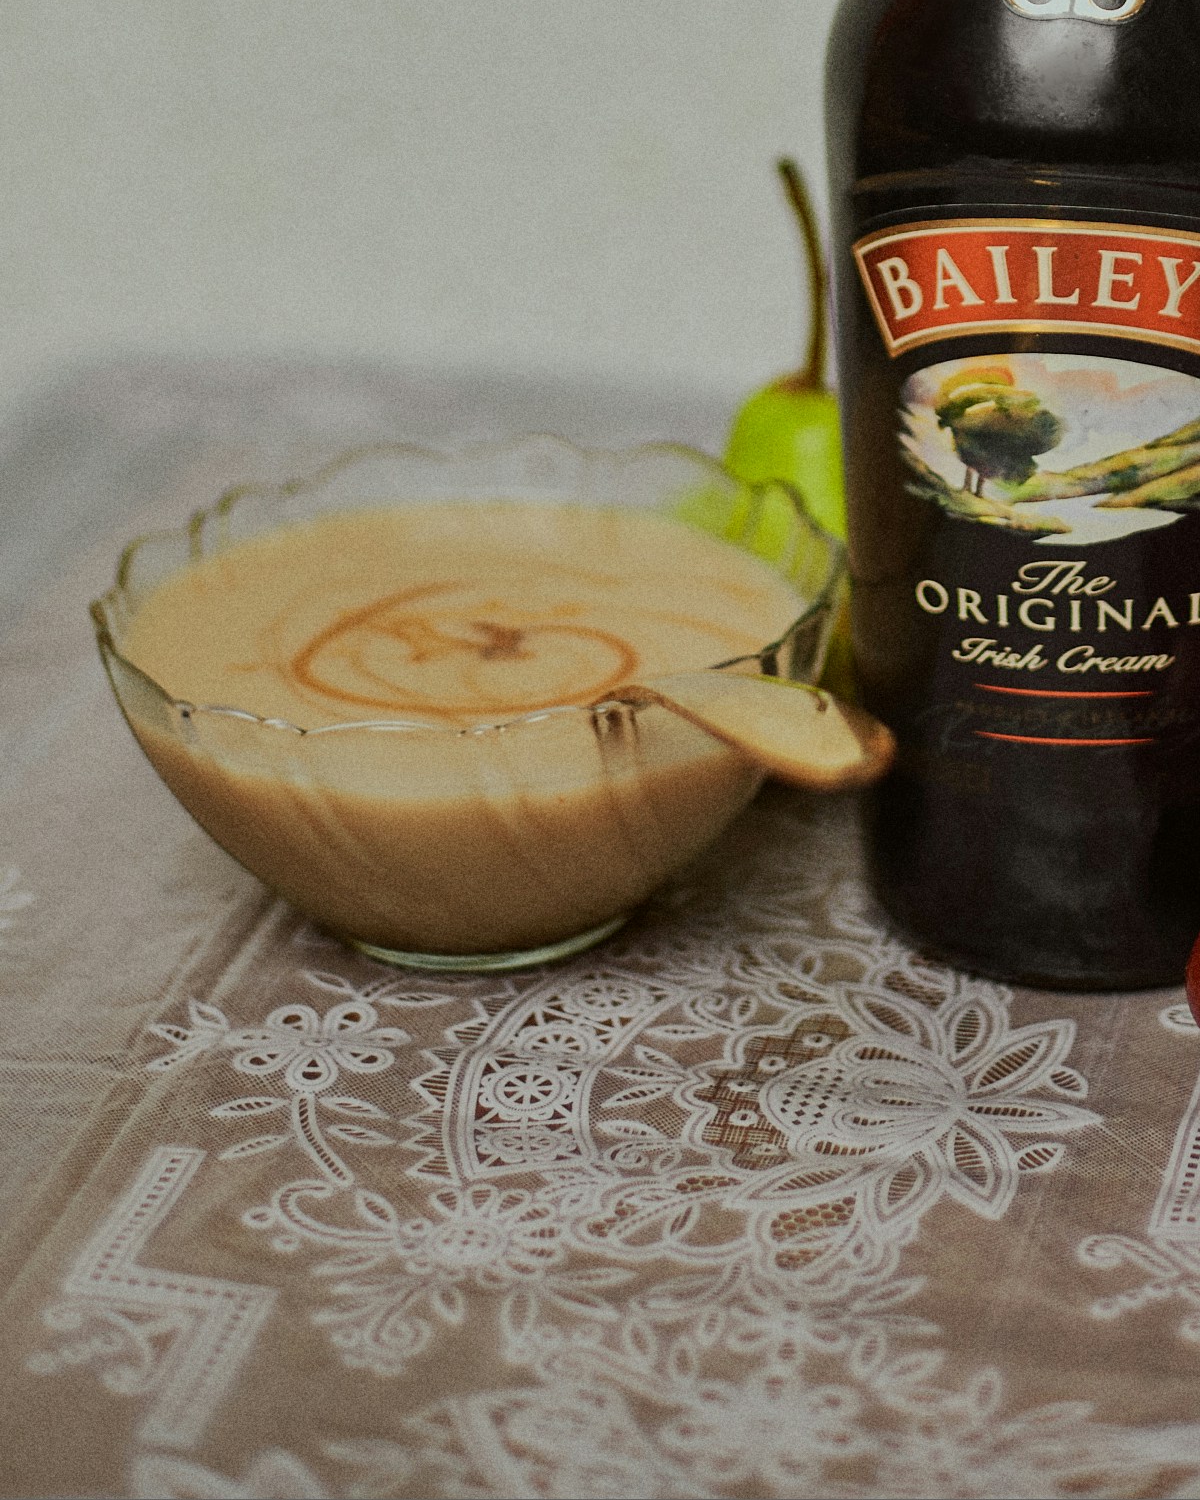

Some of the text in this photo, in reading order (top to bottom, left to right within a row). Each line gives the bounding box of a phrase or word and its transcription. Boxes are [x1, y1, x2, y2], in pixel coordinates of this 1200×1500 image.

[1012, 560, 1116, 595] The
[952, 637, 1176, 674] Irish Cream
